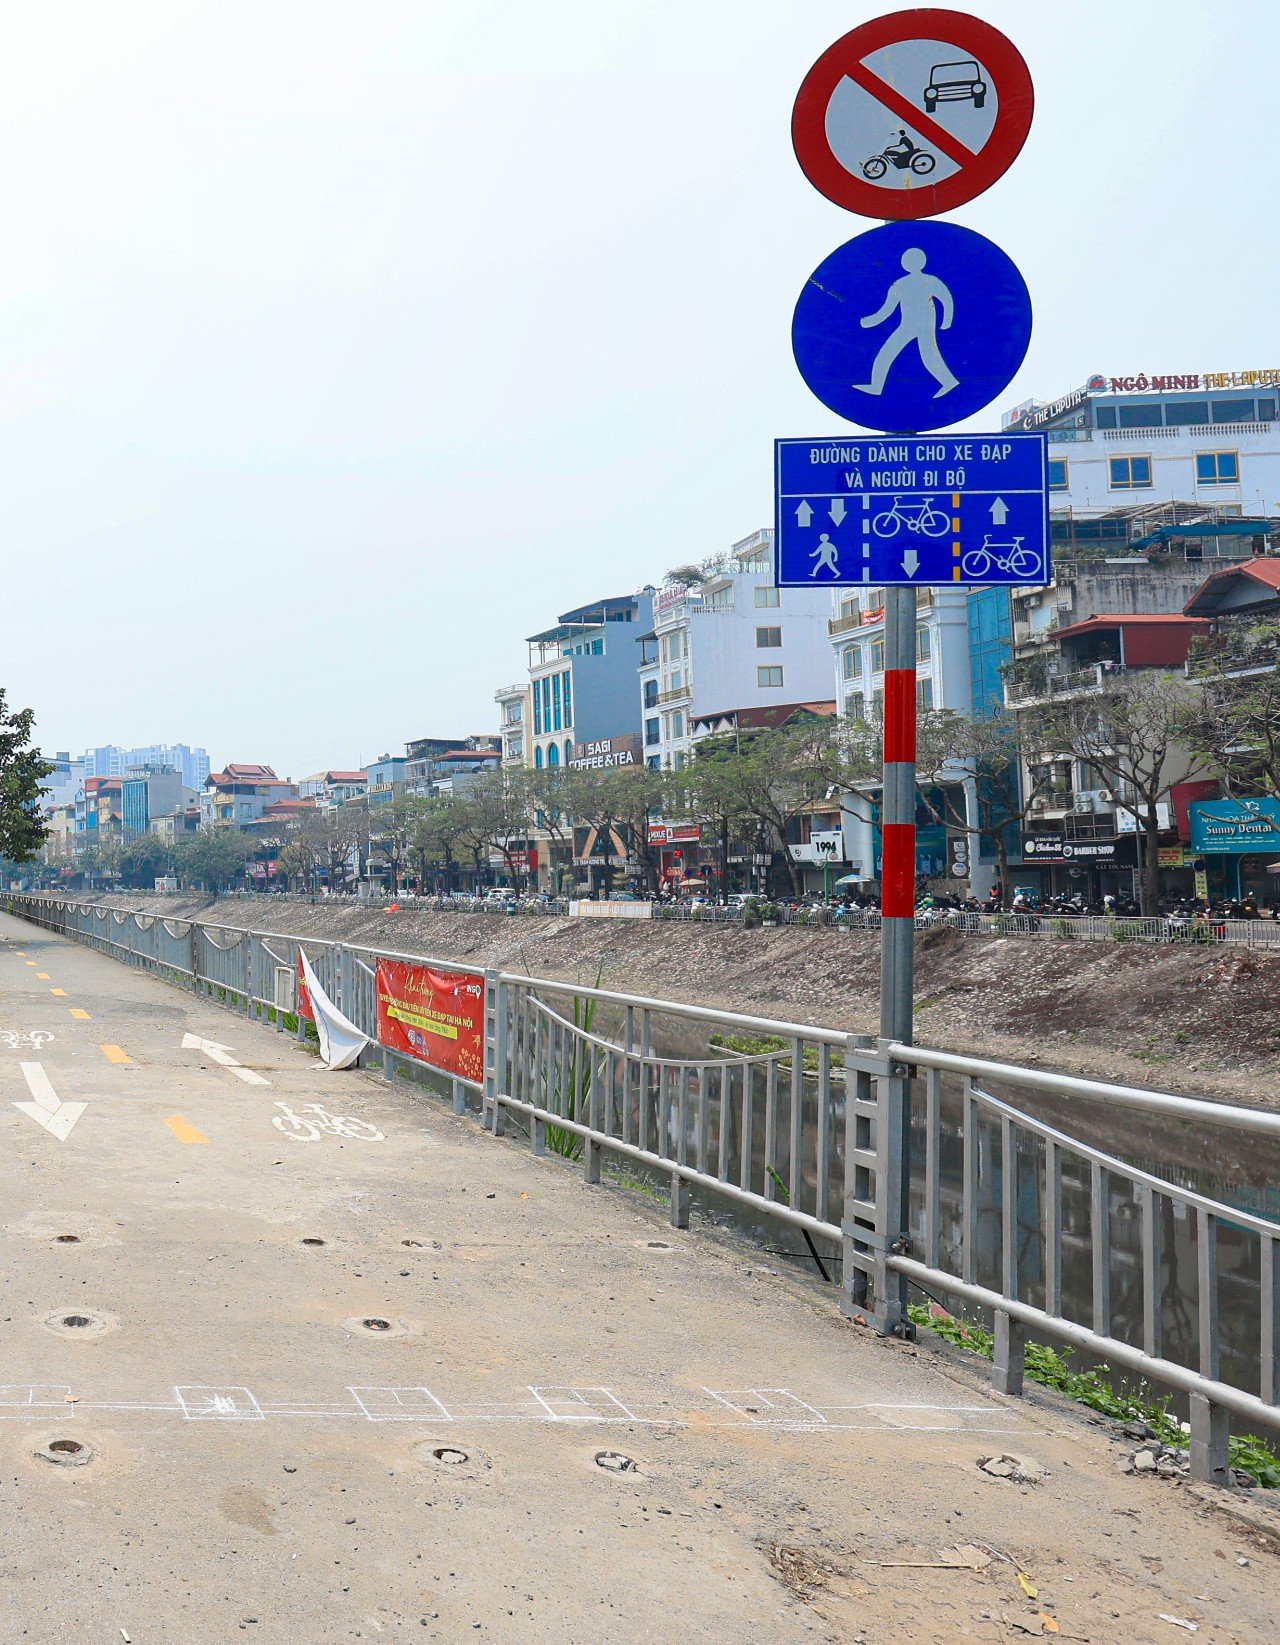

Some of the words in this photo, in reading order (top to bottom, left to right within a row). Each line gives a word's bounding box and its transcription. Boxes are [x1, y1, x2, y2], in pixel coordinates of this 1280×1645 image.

[1110, 373, 1149, 391] NGÔ
[1152, 375, 1200, 390] MINH
[1203, 373, 1229, 388] THE
[1034, 408, 1049, 426] THE
[1050, 391, 1082, 418] LAPUTA
[810, 443, 860, 464] ĐƯỜNG
[868, 442, 909, 463] DÀNH
[916, 445, 946, 461] CHO
[953, 444, 973, 461] XE
[981, 444, 1012, 463] ĐẠP
[845, 468, 864, 488] VÀ
[871, 466, 916, 487] NGƯỜI
[923, 470, 938, 487] ĐI
[946, 467, 966, 489] BỘ
[588, 740, 611, 755] SAGI
[1206, 825, 1236, 836] Sunny
[1238, 824, 1272, 833] Dental
[815, 841, 837, 853] 1994
[1074, 846, 1097, 855] BARBER
[455, 1015, 462, 1025] HÀ
[463, 1017, 474, 1031] NỘI
